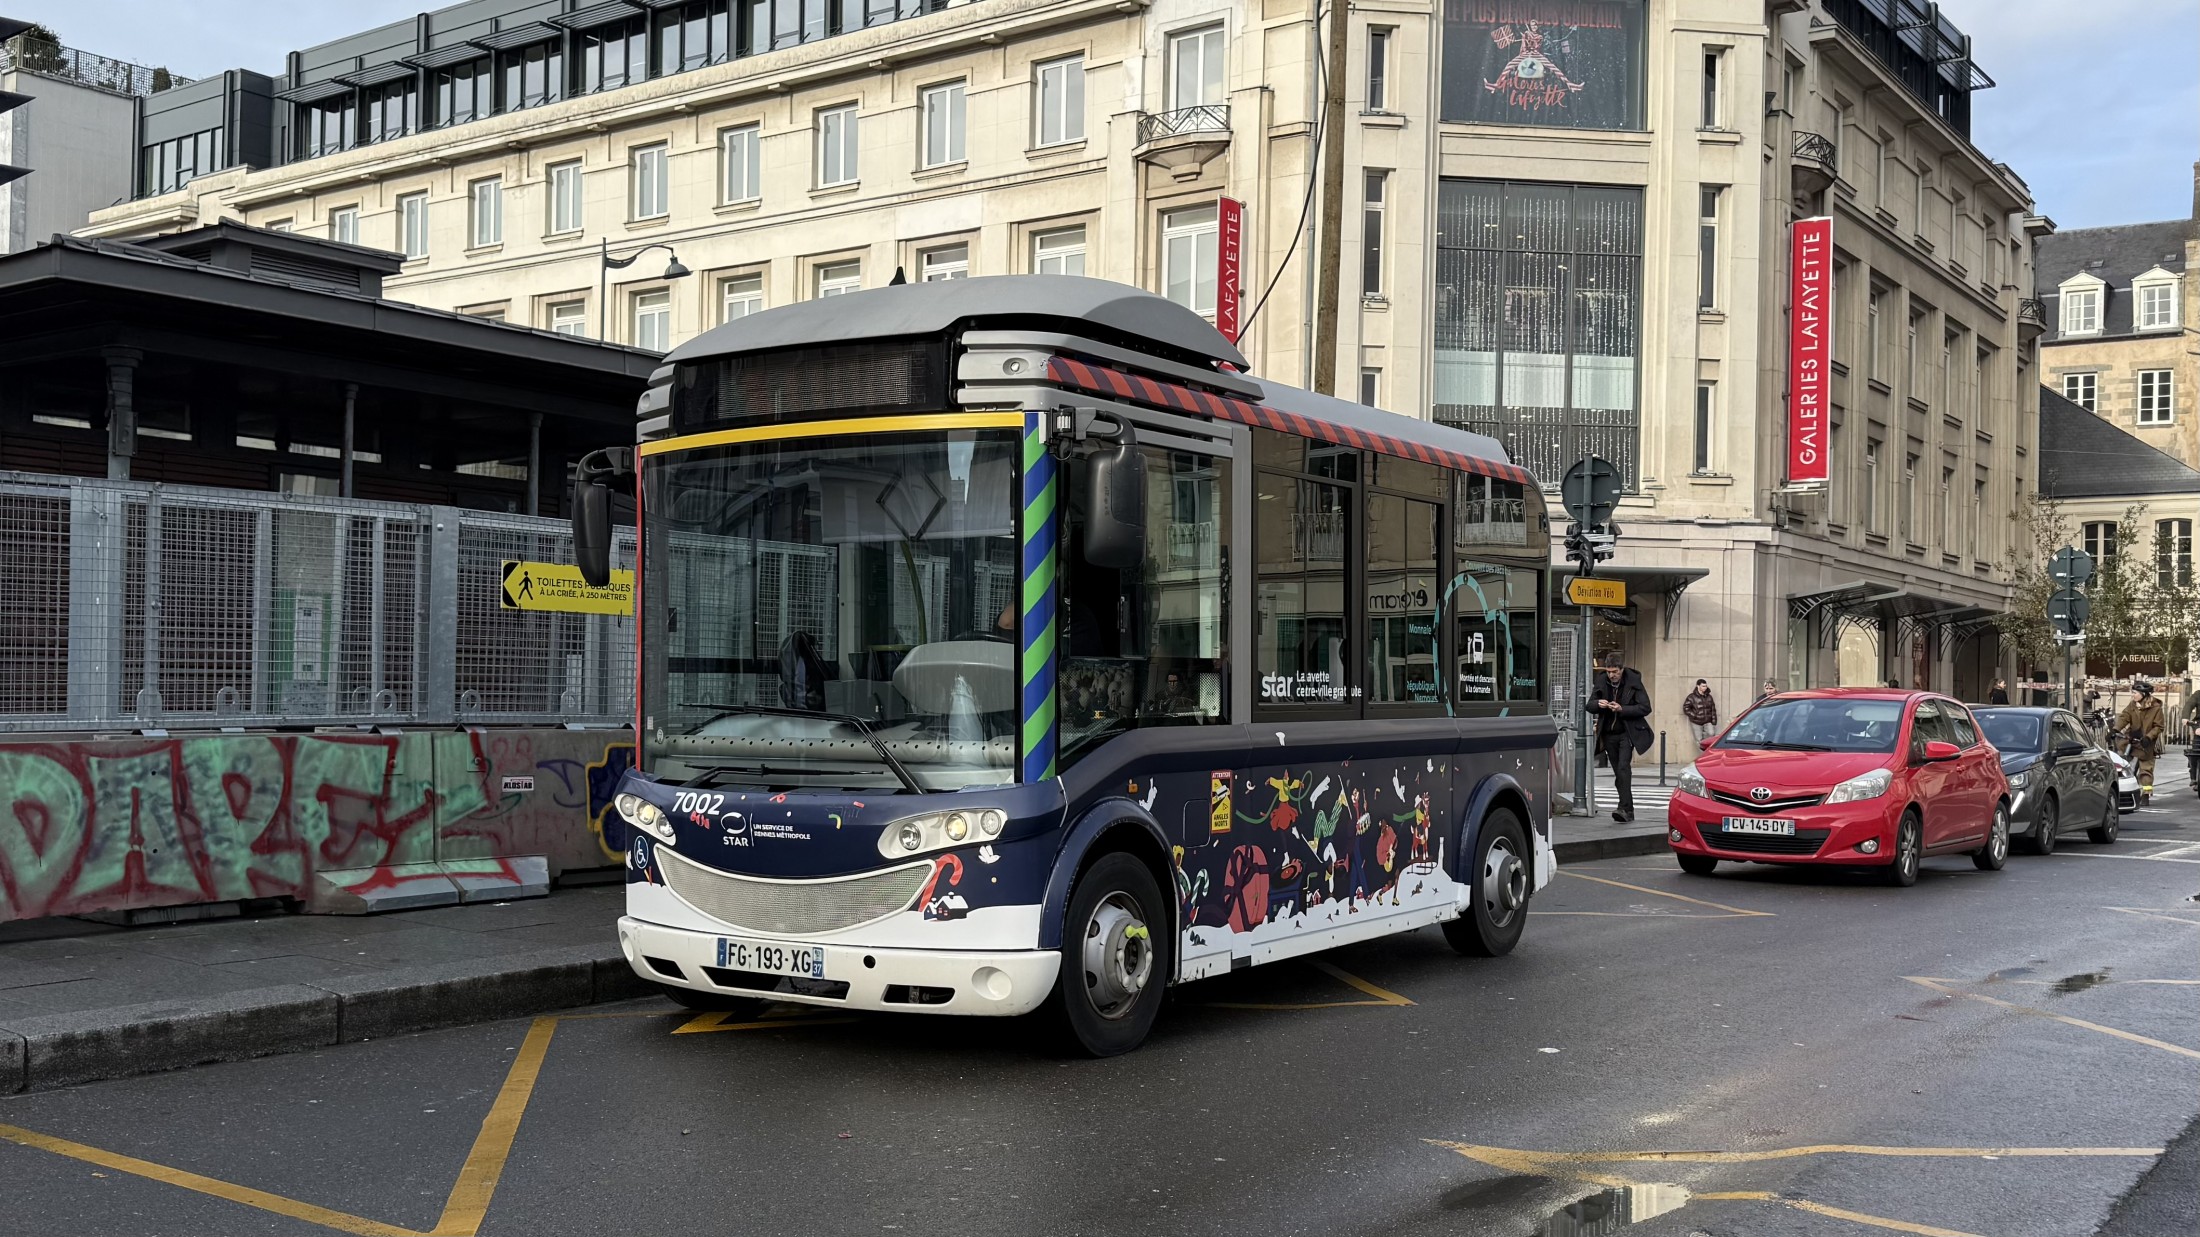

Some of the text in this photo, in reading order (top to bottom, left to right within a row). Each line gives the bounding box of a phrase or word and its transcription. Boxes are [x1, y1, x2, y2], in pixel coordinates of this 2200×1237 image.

[1463, 0, 1496, 23] PLUS
[1563, 1, 1621, 28] CADEAUX
[1224, 211, 1239, 333] LAFAYETTE
[1800, 231, 1820, 465] GALERIES LAFAYETTE
[537, 577, 583, 589] TOILETTES
[546, 588, 555, 596] LA
[557, 588, 579, 599] CRIÉE,
[600, 591, 627, 601] MÈTRES
[1408, 623, 1432, 635] Monnaie
[1296, 670, 1330, 683] La avette
[1513, 677, 1536, 687] Parlement
[1261, 671, 1293, 697] star
[1473, 685, 1491, 694] demande
[672, 792, 725, 815] 7002
[1732, 818, 1785, 832] CV-145-DY
[723, 836, 749, 847] STAR
[776, 832, 811, 840] MÉTROPOLE
[728, 943, 811, 973] FG-193-XG
[813, 963, 822, 974] 37
